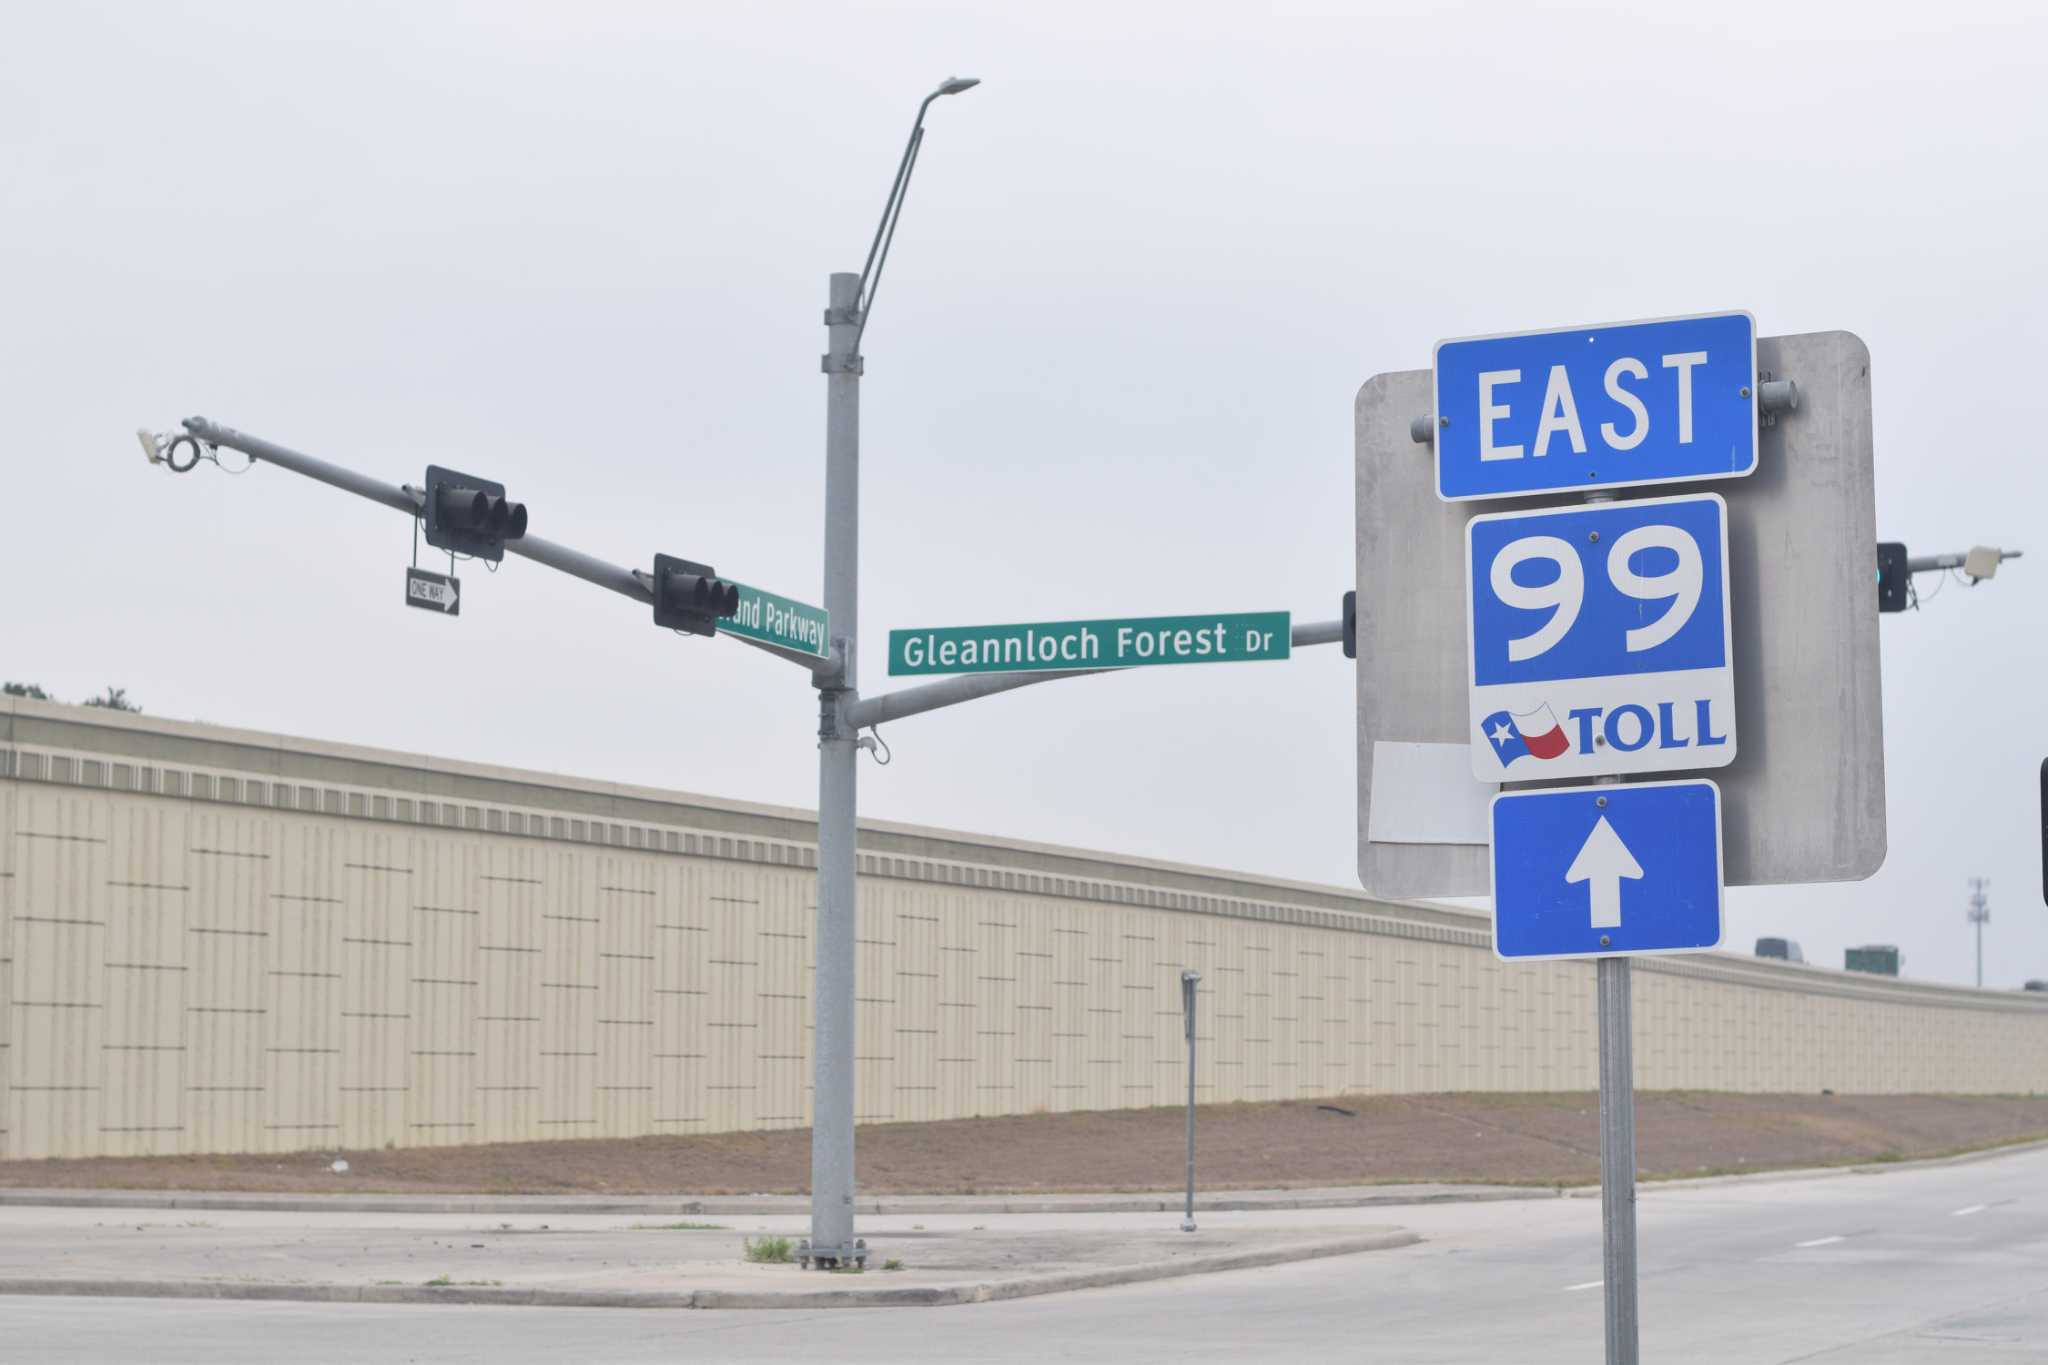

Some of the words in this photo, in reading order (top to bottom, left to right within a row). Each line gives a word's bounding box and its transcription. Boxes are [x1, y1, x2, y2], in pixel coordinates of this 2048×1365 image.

[1478, 351, 1708, 462] EAST
[411, 580, 427, 598] ONE
[429, 584, 444, 601] WAY
[1490, 525, 1704, 663] 99
[719, 597, 760, 629] and
[766, 603, 825, 655] Parkway
[903, 627, 1099, 667] Gleannloch
[1118, 623, 1227, 658] Forest
[1246, 629, 1273, 652] Dr
[1568, 699, 1727, 755] TOLL
